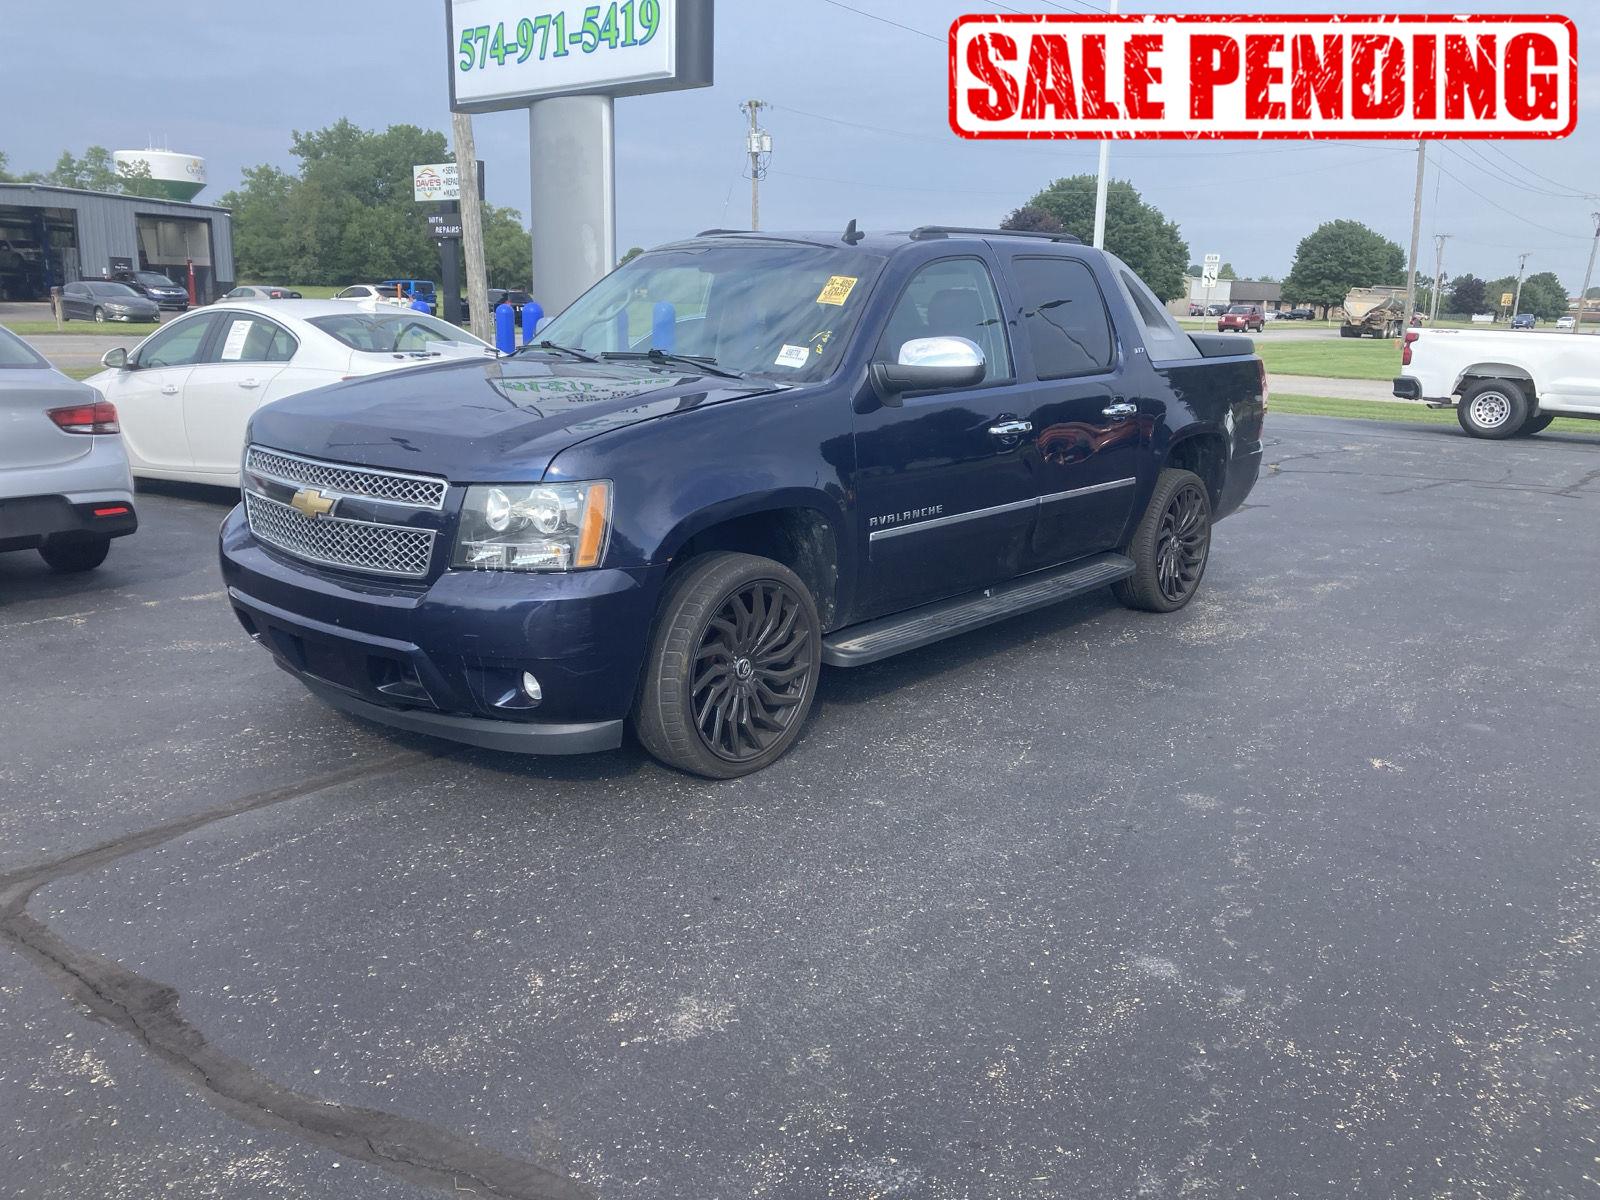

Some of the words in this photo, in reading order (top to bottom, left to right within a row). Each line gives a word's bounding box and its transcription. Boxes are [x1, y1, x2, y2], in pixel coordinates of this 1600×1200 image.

[459, 0, 661, 72] 574-971-5419
[445, 166, 458, 174] SERVI
[416, 179, 441, 187] DAVE'S
[869, 504, 943, 526] AVALANCHE
